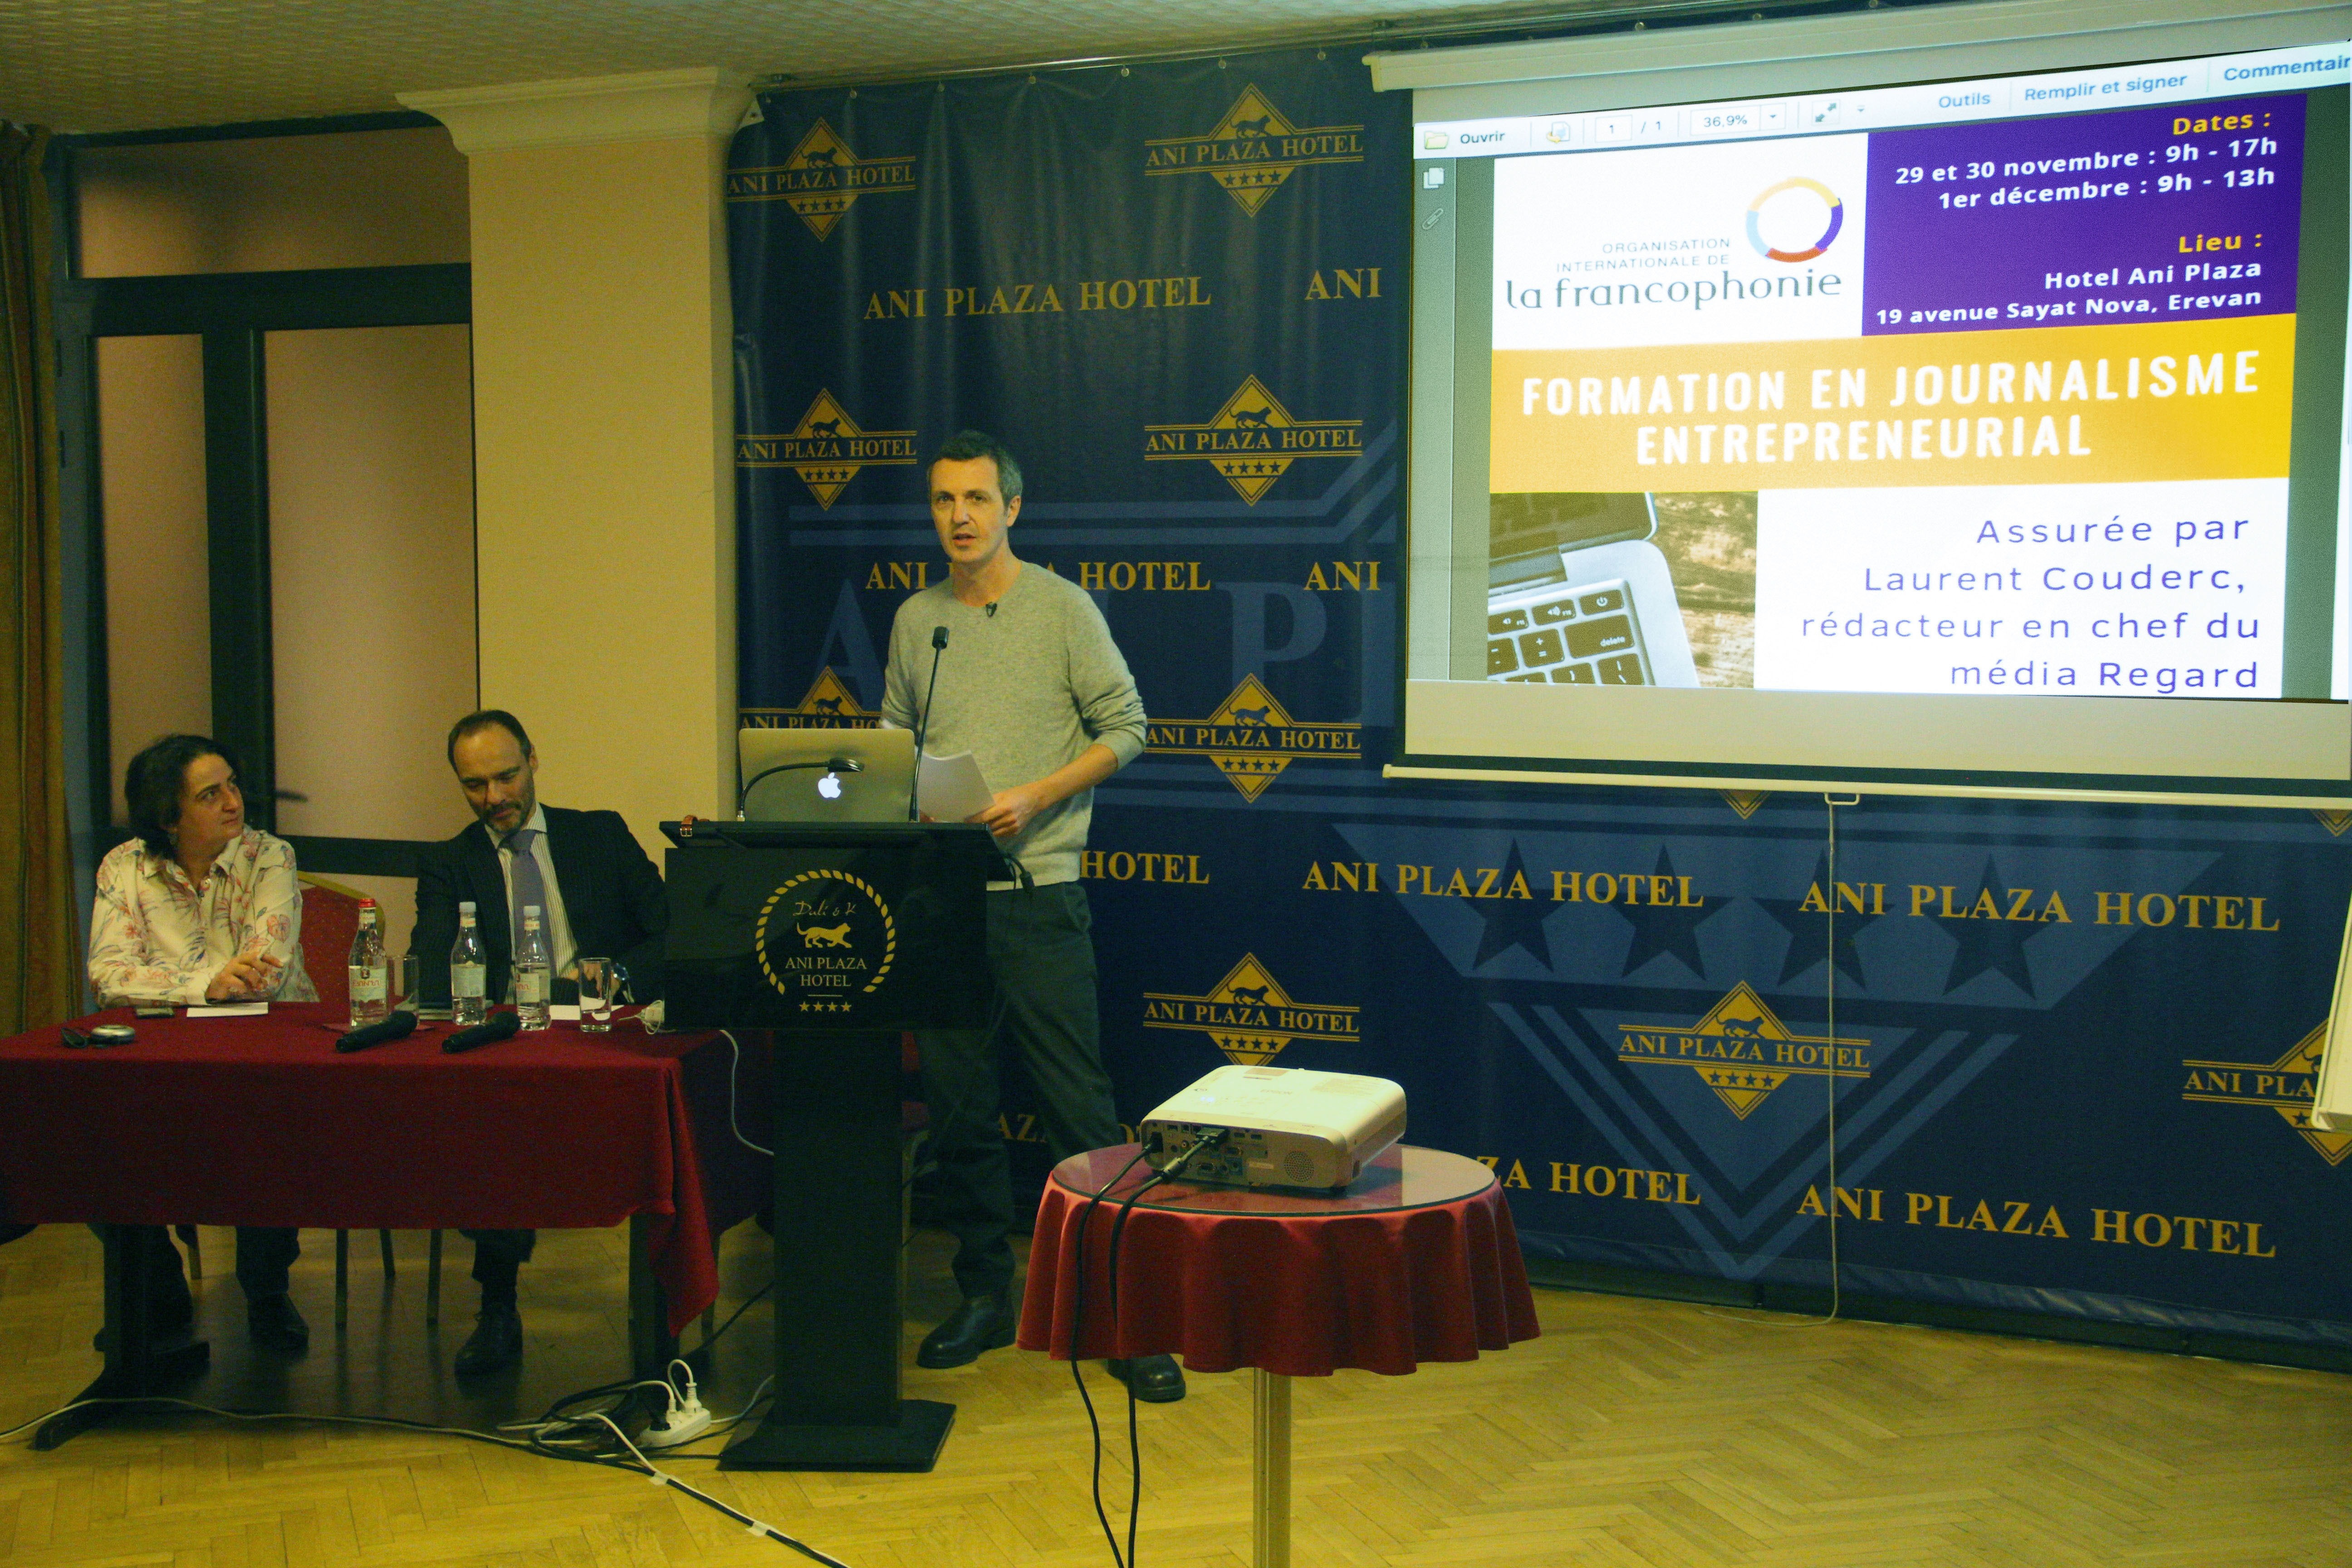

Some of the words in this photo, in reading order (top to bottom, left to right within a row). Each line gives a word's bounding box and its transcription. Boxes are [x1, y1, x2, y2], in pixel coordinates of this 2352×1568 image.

[1938, 92, 1991, 109] Outils
[2024, 82, 2094, 102] Remplir
[2102, 78, 2121, 94] et
[2126, 72, 2188, 96] signer
[1703, 113, 1748, 129] 36,9%
[2172, 113, 2254, 136] Dates
[1146, 146, 1187, 167] ANI
[1197, 141, 1271, 163] PLAZA
[1282, 134, 1363, 157] HOTEL
[1460, 129, 1506, 145] Ouvrir
[1895, 166, 1924, 185] 29
[1932, 163, 1958, 182] et
[1966, 161, 1995, 180] 30
[2004, 147, 2139, 177] novembre
[2165, 143, 2199, 164] 9h
[2228, 137, 2277, 159] 17h
[727, 176, 768, 194] ANI
[776, 171, 838, 191] PLAZA
[846, 164, 916, 186] HOTEL
[1939, 191, 1981, 209] 1er
[1989, 177, 2130, 206] décembre
[2157, 174, 2191, 194] 9h
[2222, 168, 2274, 190] 13h
[1602, 238, 1730, 253] ORGANISATION
[2178, 234, 2242, 253] Lieu
[1556, 255, 1703, 272] INTERNATIONALE
[1708, 254, 1729, 265] DE
[2045, 268, 2118, 289] Hotel
[2127, 265, 2174, 285] Ani
[2185, 262, 2261, 282] Plaza
[863, 288, 927, 319] ANI
[944, 283, 1064, 317] PLAZA
[1078, 276, 1211, 311] HOTEL
[1304, 267, 1382, 301] ANI
[1507, 279, 1542, 309] la
[1556, 268, 1842, 310] francophonie
[1877, 309, 1902, 324] 19
[1910, 304, 1999, 323] avenue
[2006, 297, 2076, 322] Sayat
[2085, 295, 2157, 317] Nova,
[2168, 290, 2261, 312] Erevan
[1523, 370, 1786, 415] FORMATION
[1811, 368, 1866, 409] EN
[1890, 350, 2259, 407] JOURNALISME
[737, 442, 777, 460] ANI
[784, 440, 841, 458] PLAZA
[849, 439, 917, 457] HOTEL
[1145, 433, 1186, 451] ANI
[1196, 431, 1271, 451] PLAZA
[1282, 429, 1362, 449] HOTEL
[1636, 414, 2092, 466] ENTREPRENEURIAL
[1976, 515, 2153, 544] Assurée
[2176, 518, 2249, 548] par
[865, 562, 929, 589] ANI
[1078, 561, 1211, 591] HOTEL
[1303, 561, 1381, 592] ANI
[1864, 565, 2023, 592] Laurent
[2043, 563, 2245, 595] Couderc,
[1802, 611, 2004, 638] rédacteur
[2023, 615, 2070, 638] en
[2091, 612, 2188, 639] chef
[2206, 612, 2259, 639] du
[1951, 659, 2077, 686] média
[2099, 661, 2258, 695] Regard
[1146, 727, 1186, 745] ANI
[1196, 728, 1270, 747] PLAZA
[1280, 730, 1361, 750] HOTEL
[1080, 850, 1210, 884] HOTEL
[1302, 860, 1380, 893] ANI
[1396, 864, 1533, 900] PLAZA
[1550, 870, 1704, 908] HOTEL
[1798, 880, 1887, 916] ANI
[1907, 885, 2072, 924] PLAZA
[2093, 891, 2281, 932] HOTEL
[785, 957, 813, 970] ANI
[817, 957, 867, 970] PLAZA
[800, 975, 852, 988] HOTEL
[1144, 1001, 1185, 1021] ANI
[1195, 1005, 1270, 1027] PLAZA
[1279, 1012, 1360, 1034] HOTEL
[1619, 1034, 1667, 1055] ANI
[1677, 1038, 1764, 1062] PLAZA
[1775, 1043, 1870, 1068] HOTEL
[2183, 1070, 2241, 1093] ANI
[2255, 1074, 2316, 1098] PLA
[1548, 1161, 1701, 1205] HOTEL
[1796, 1183, 1884, 1221] ANI
[1904, 1191, 2069, 1240] PLAZA
[2090, 1208, 2277, 1258] HOTEL
